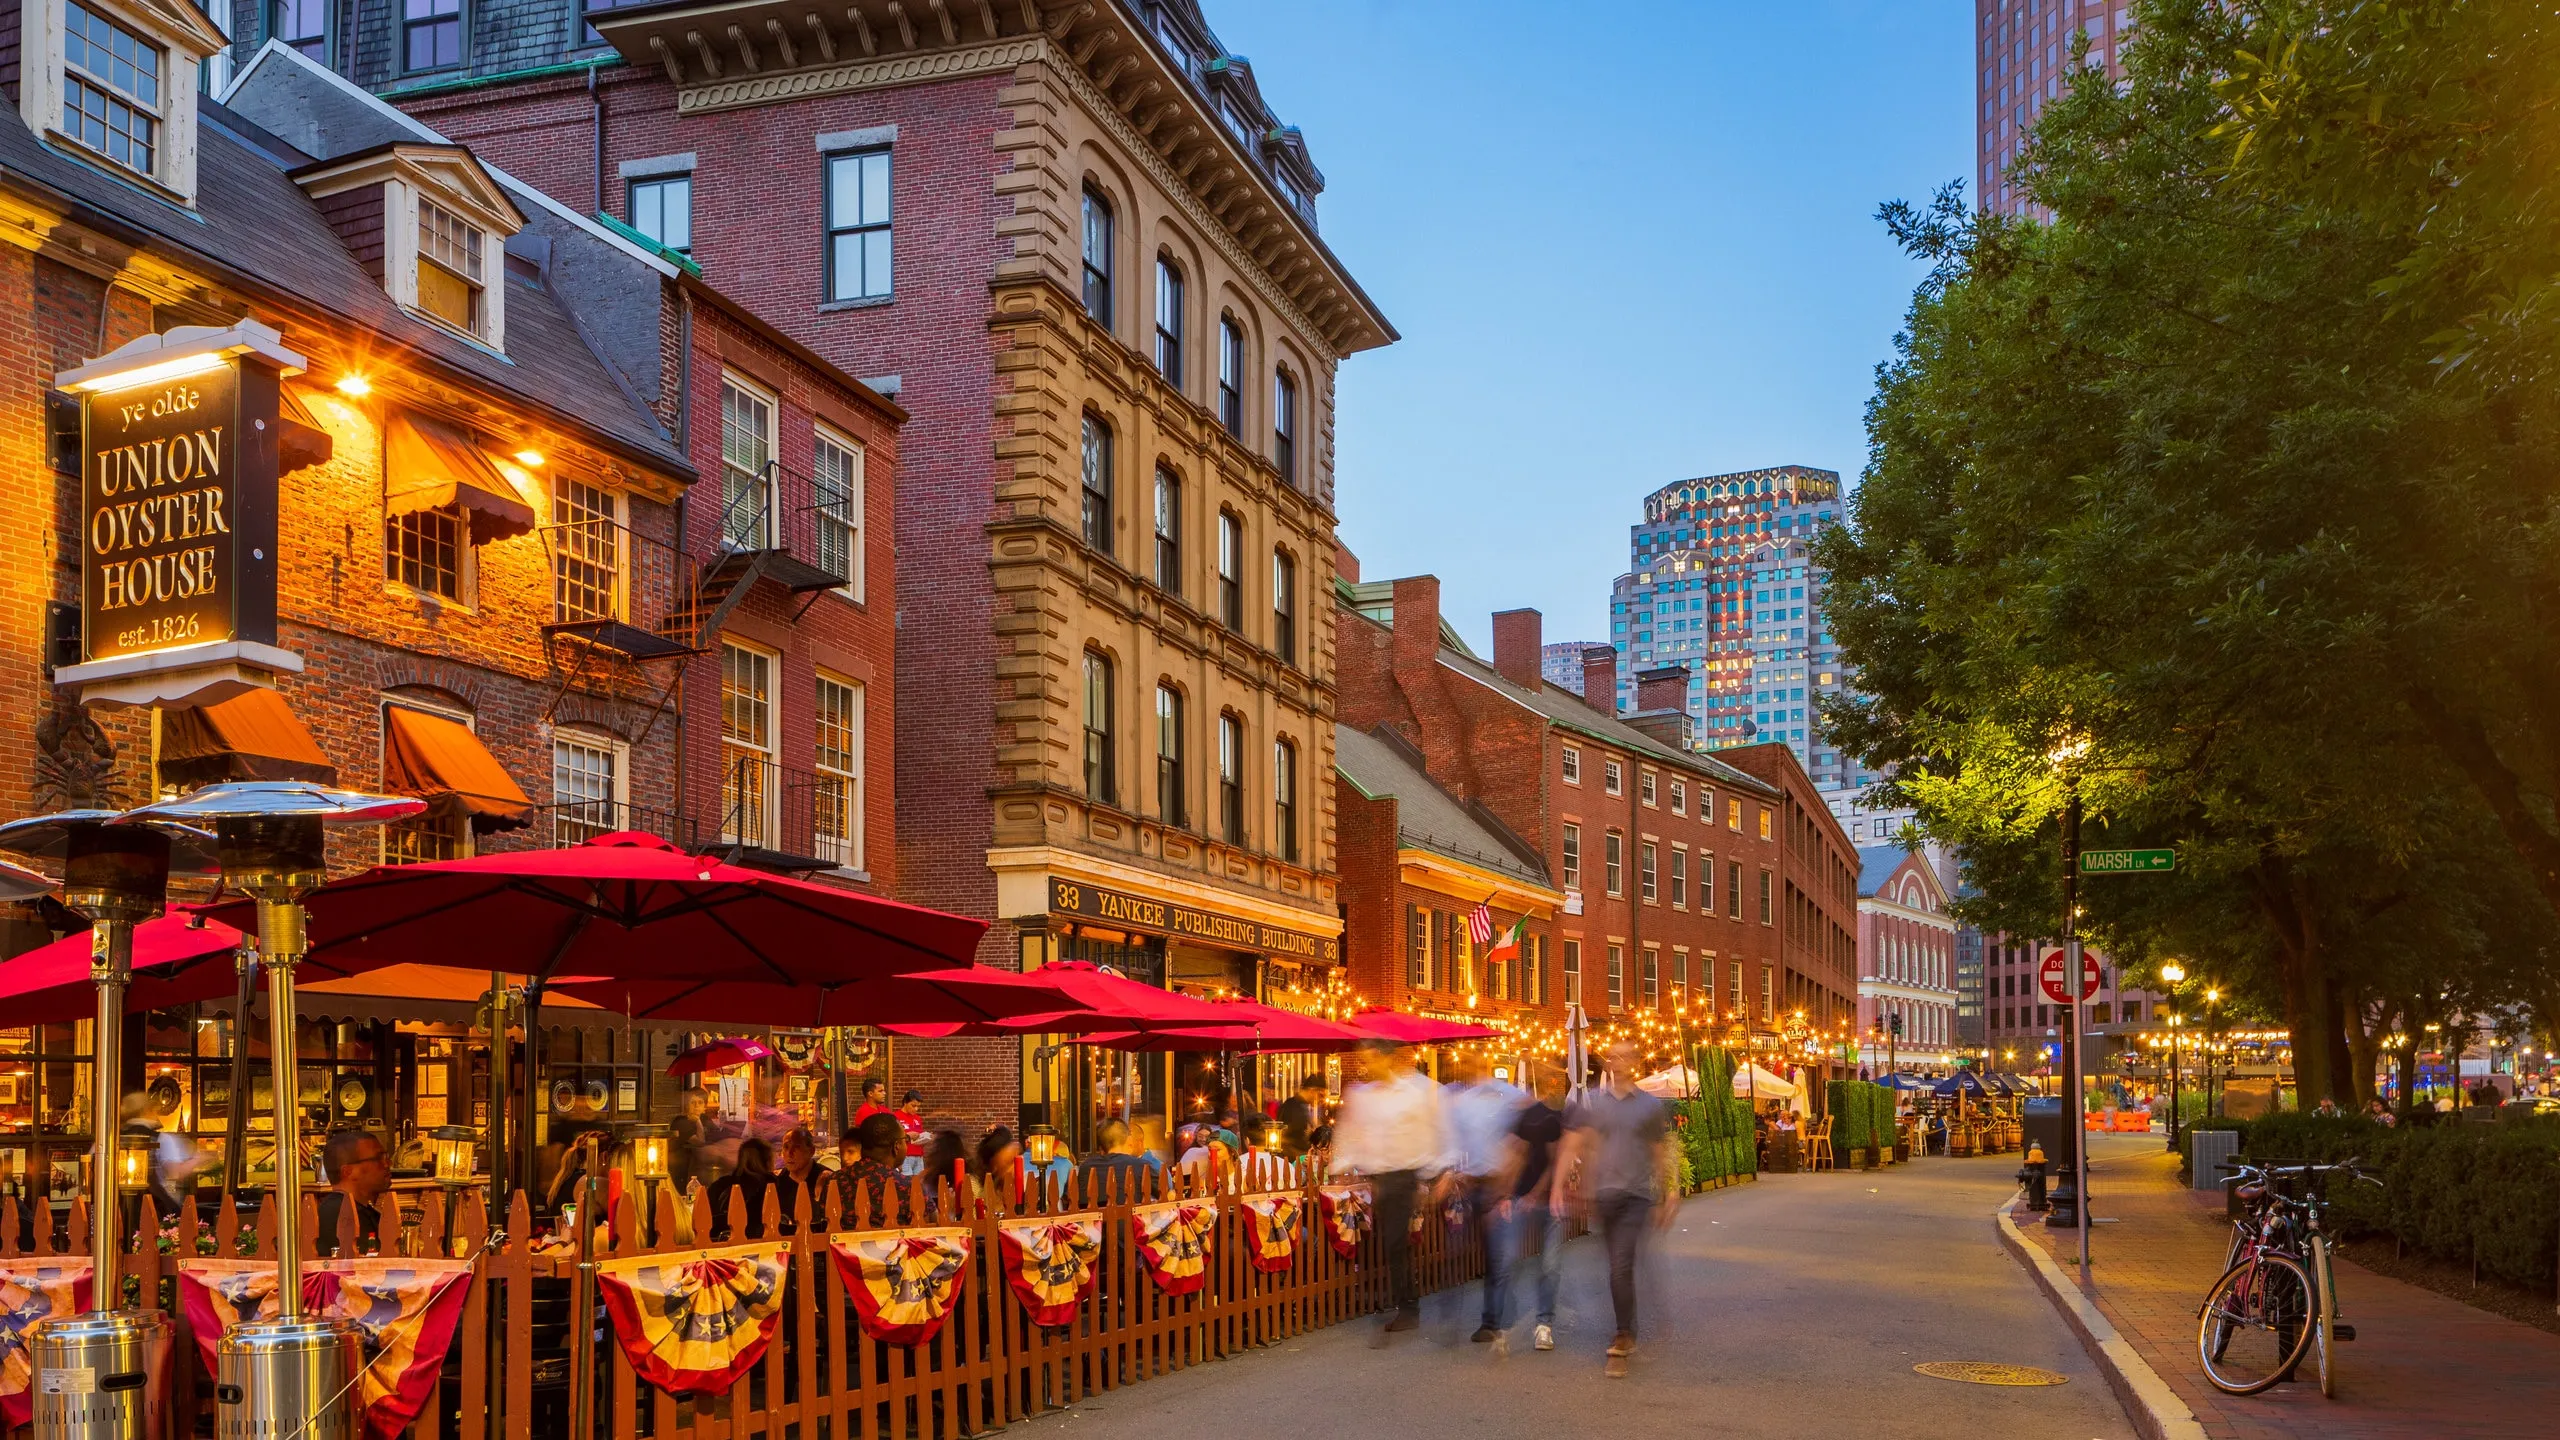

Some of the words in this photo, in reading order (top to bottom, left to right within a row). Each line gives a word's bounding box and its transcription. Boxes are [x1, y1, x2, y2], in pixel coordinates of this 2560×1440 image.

[121, 402, 145, 432] ye
[152, 384, 200, 418] olde
[97, 426, 223, 497] UNION
[92, 486, 229, 555] OYSTER
[100, 546, 217, 611] HOUSE
[2086, 853, 2133, 869] MARSH
[2136, 860, 2144, 868] LN
[1057, 884, 1079, 910] 33
[1097, 892, 1165, 927] YANKEE
[1173, 908, 1256, 944] PUBLISHING
[1262, 929, 1315, 956] BUILDING
[1324, 941, 1337, 959] 33
[2051, 960, 2064, 968] DO
[1730, 1030, 1745, 1040] SOB
